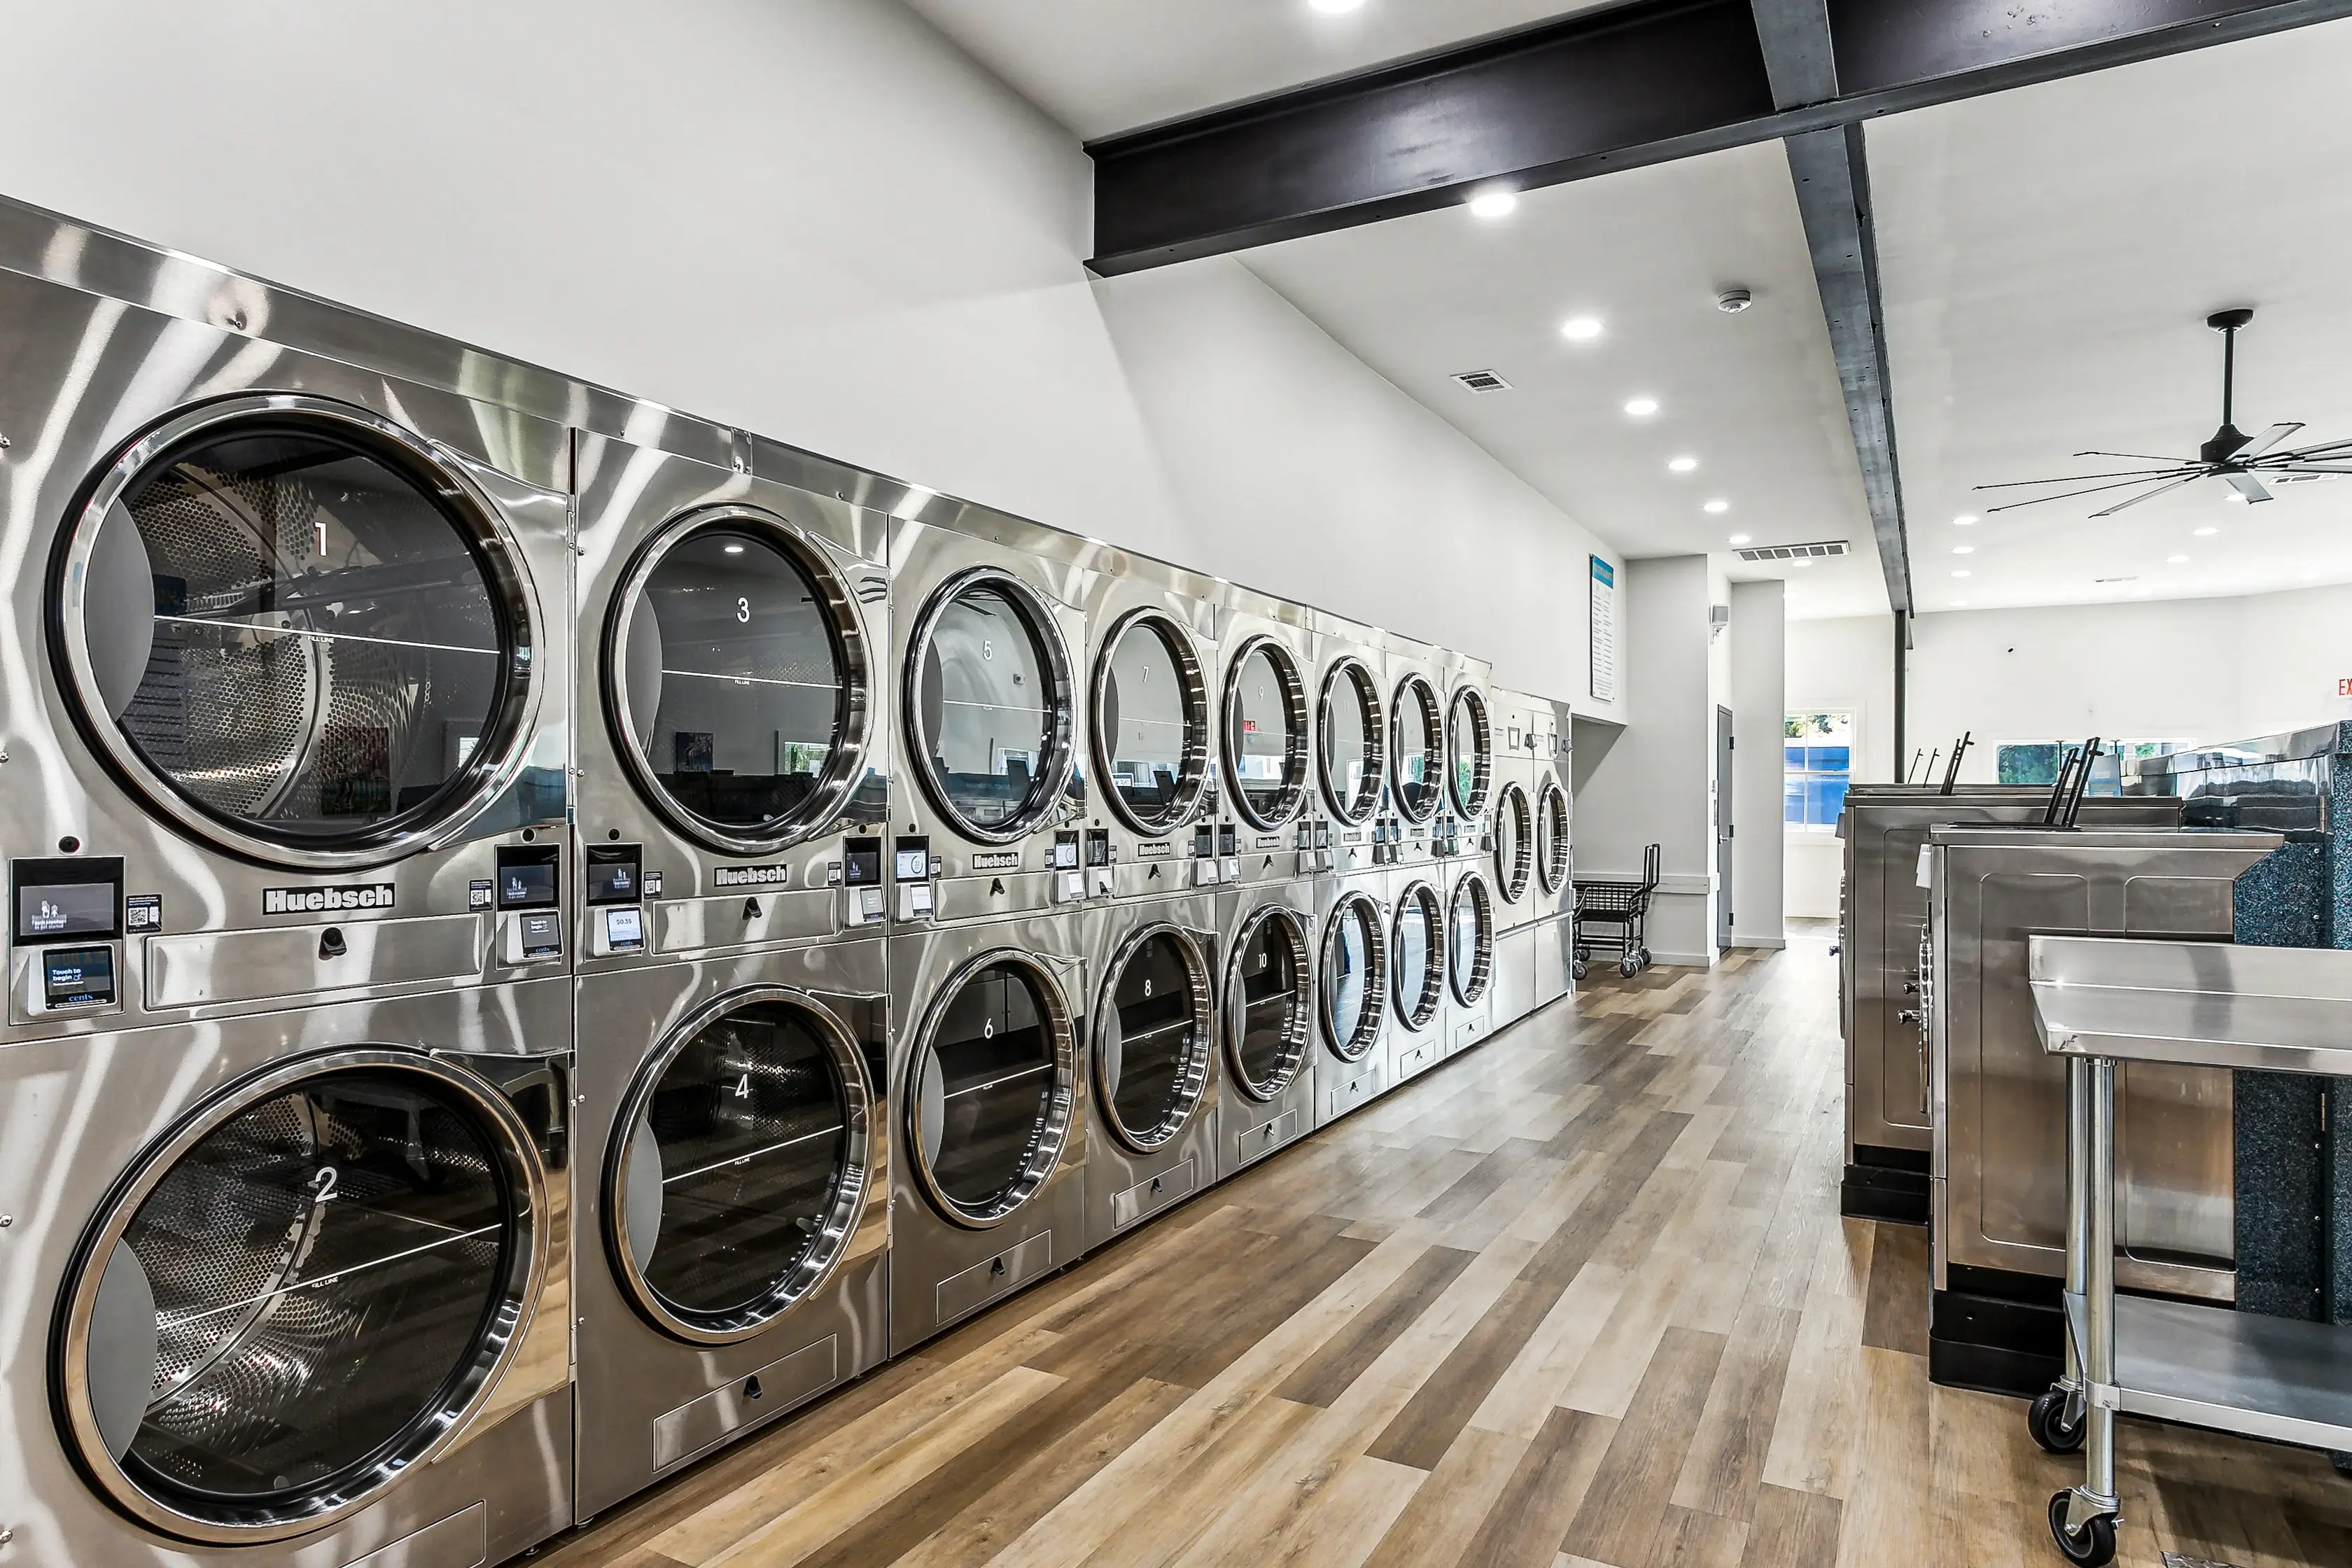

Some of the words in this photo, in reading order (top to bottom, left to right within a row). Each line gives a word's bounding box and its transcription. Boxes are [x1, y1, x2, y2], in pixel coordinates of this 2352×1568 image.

[315, 522, 328, 556] 1
[736, 596, 750, 623] 3
[983, 640, 993, 660] 5
[1142, 665, 1149, 682] 7
[1259, 686, 1264, 700] 9
[974, 853, 1018, 868] Huebsch
[716, 865, 786, 885] Huebsch
[265, 885, 393, 913] Huebsch
[1259, 953, 1267, 968] 10
[1144, 979, 1152, 996] 8
[984, 1017, 993, 1040] 6
[735, 1073, 749, 1099] 4
[315, 1166, 337, 1203] 2
[312, 1280, 324, 1288] FILL
[324, 1276, 339, 1285] LINE
